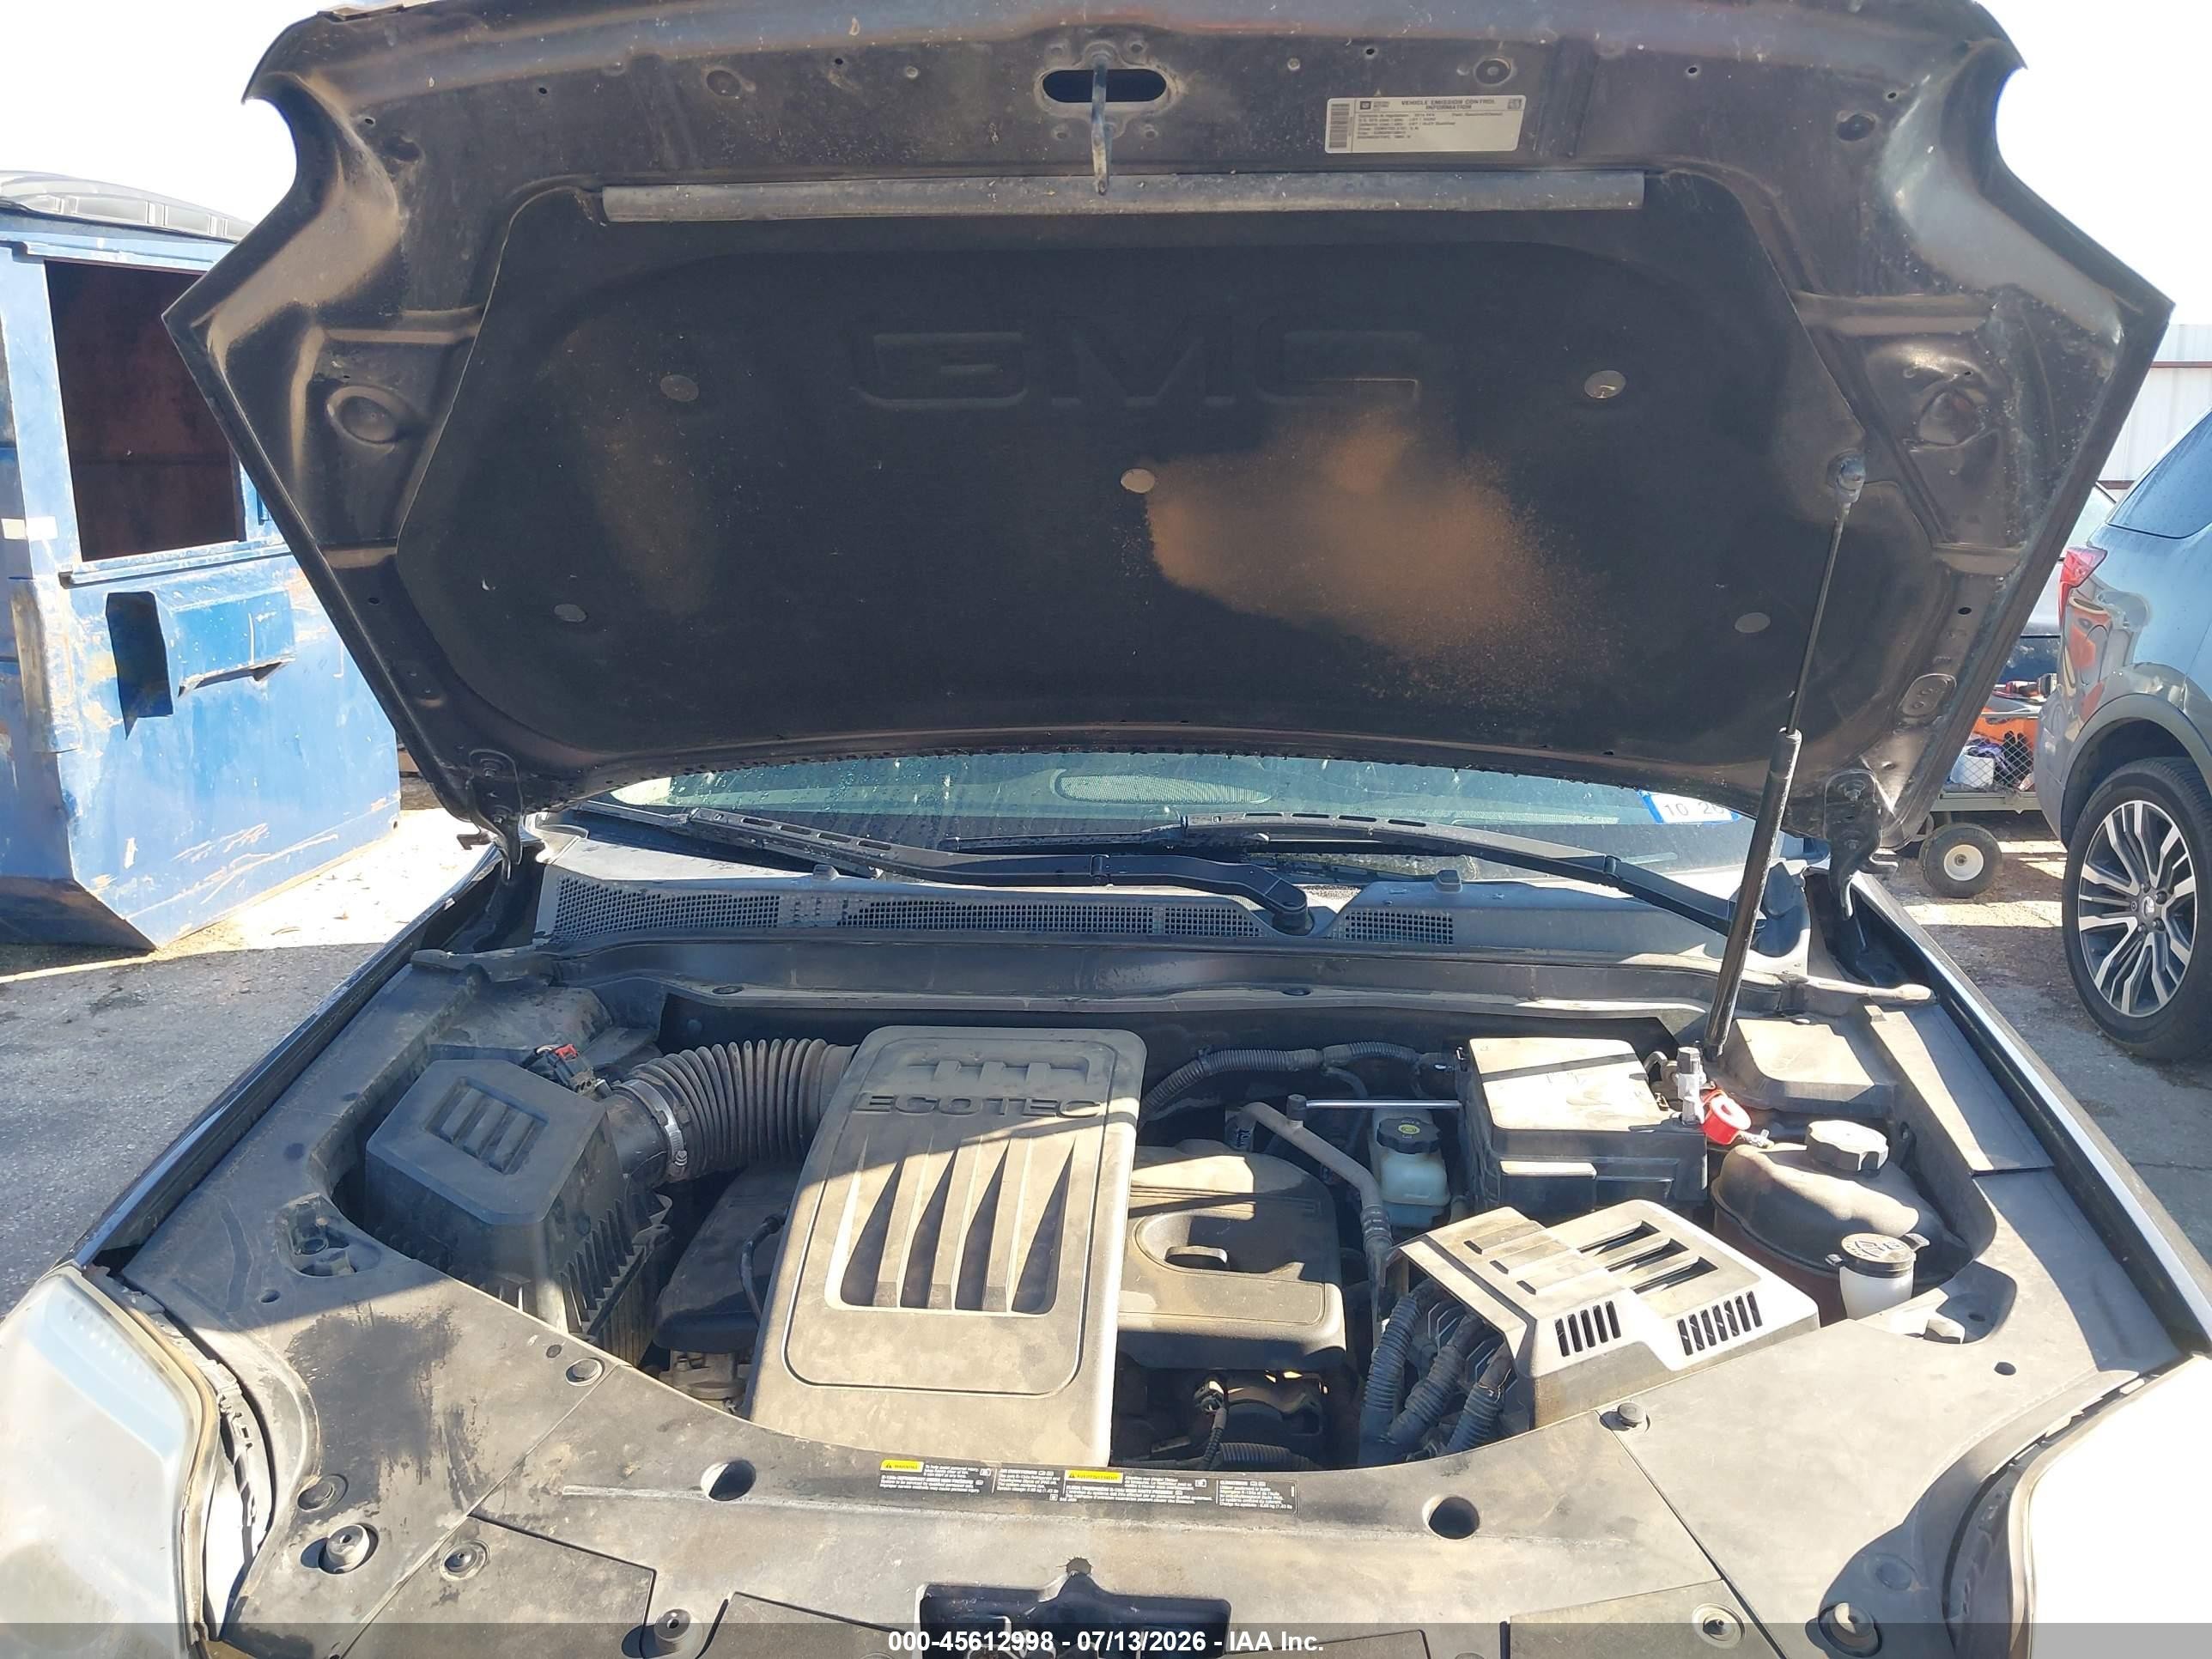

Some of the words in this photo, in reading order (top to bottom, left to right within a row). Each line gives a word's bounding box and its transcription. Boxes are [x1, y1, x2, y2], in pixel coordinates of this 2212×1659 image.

[852, 319, 1422, 409] GMC
[1663, 803, 1689, 817] 10
[853, 1092, 1102, 1117] ECOTEC
